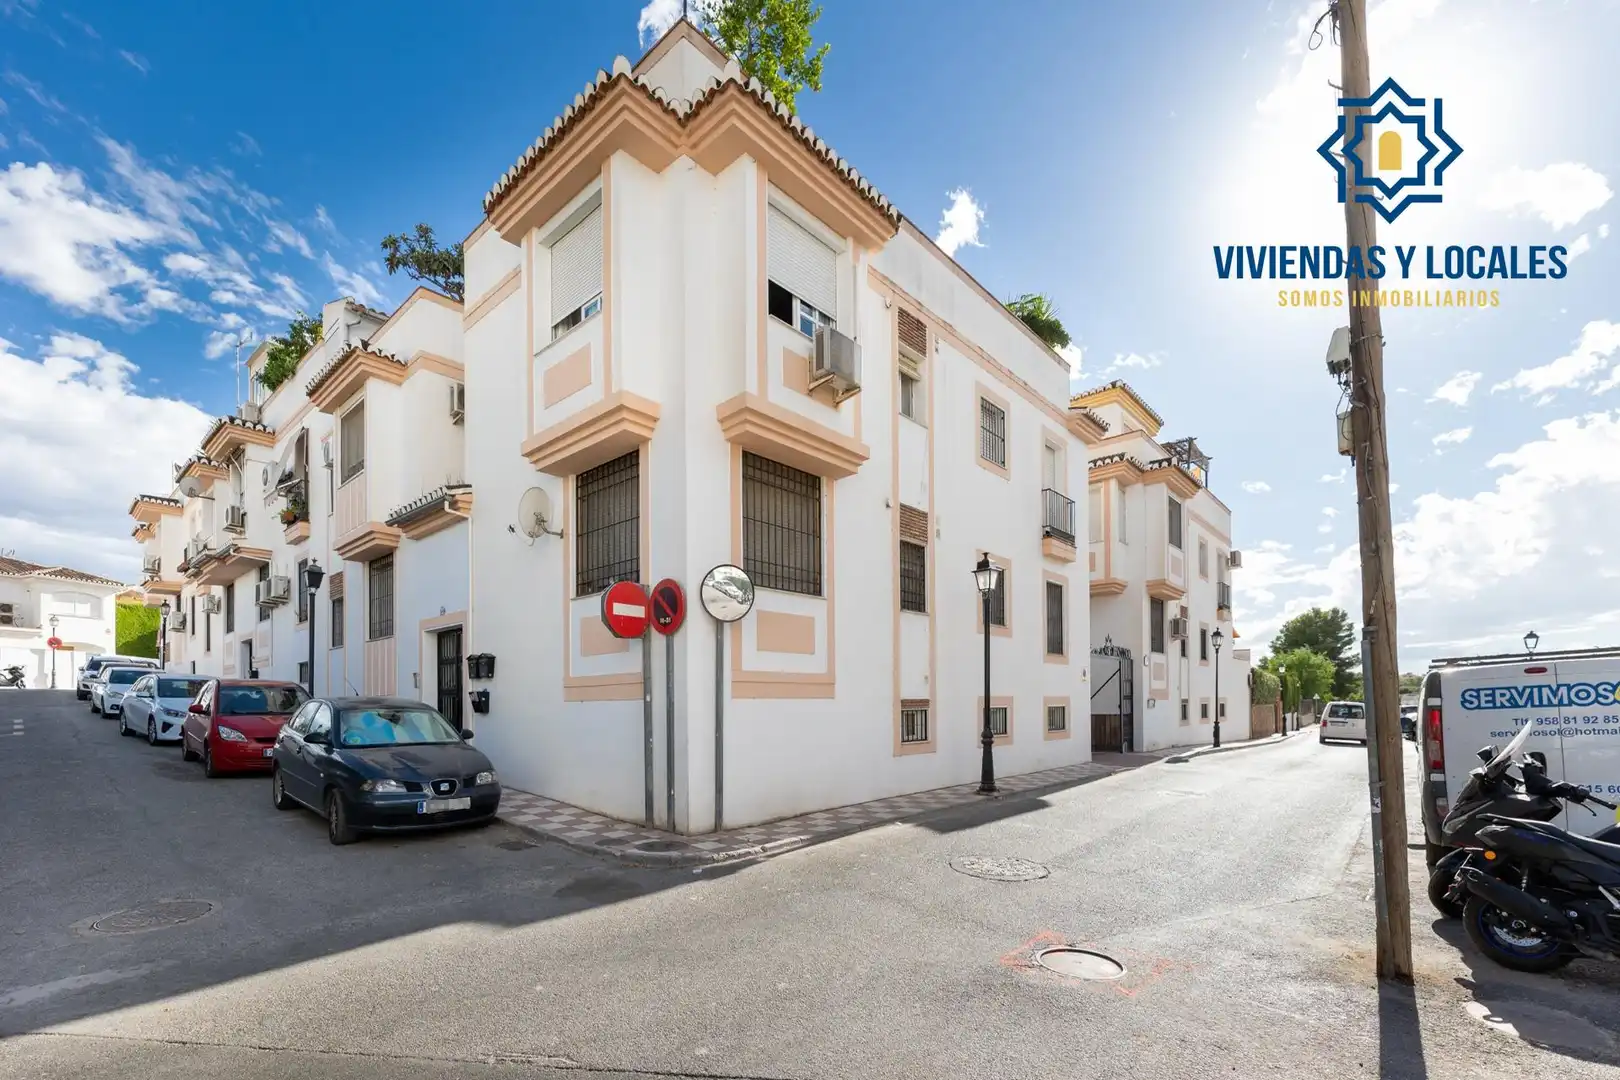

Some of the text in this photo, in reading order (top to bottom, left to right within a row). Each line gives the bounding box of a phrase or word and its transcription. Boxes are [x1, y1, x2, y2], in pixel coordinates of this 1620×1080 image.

[1536, 717, 1559, 726] 958
[1563, 716, 1577, 725] 81
[1583, 715, 1599, 724] 92
[1603, 715, 1620, 724] 85
